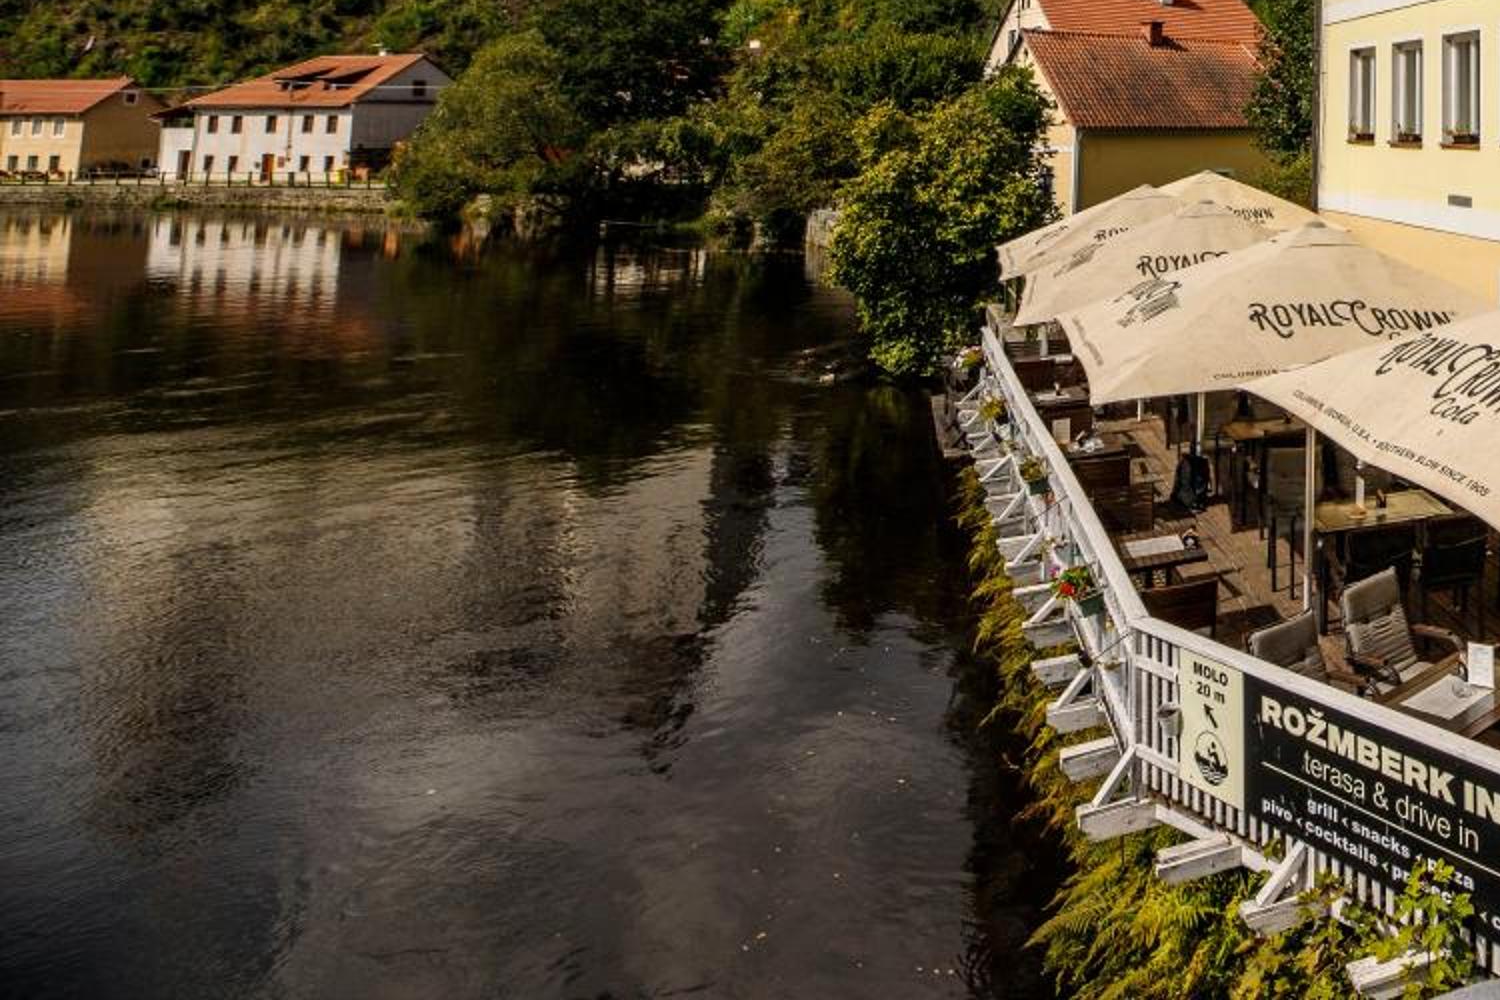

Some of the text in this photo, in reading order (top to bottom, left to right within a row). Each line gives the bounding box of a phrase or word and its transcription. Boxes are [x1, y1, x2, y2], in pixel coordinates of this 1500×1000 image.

[1248, 300, 1453, 339] ROYAL CROWN
[1375, 333, 1466, 376] ROYAL
[1430, 397, 1481, 426] Cola
[1193, 661, 1229, 687] MOLO
[1197, 681, 1225, 705] 20 m
[1261, 694, 1455, 805] ROŽMBERK
[1303, 750, 1480, 854] terasa & drive in
[1261, 798, 1293, 822] pivo
[1305, 819, 1379, 867] cocktails
[1306, 798, 1475, 892] grill snacks pza
